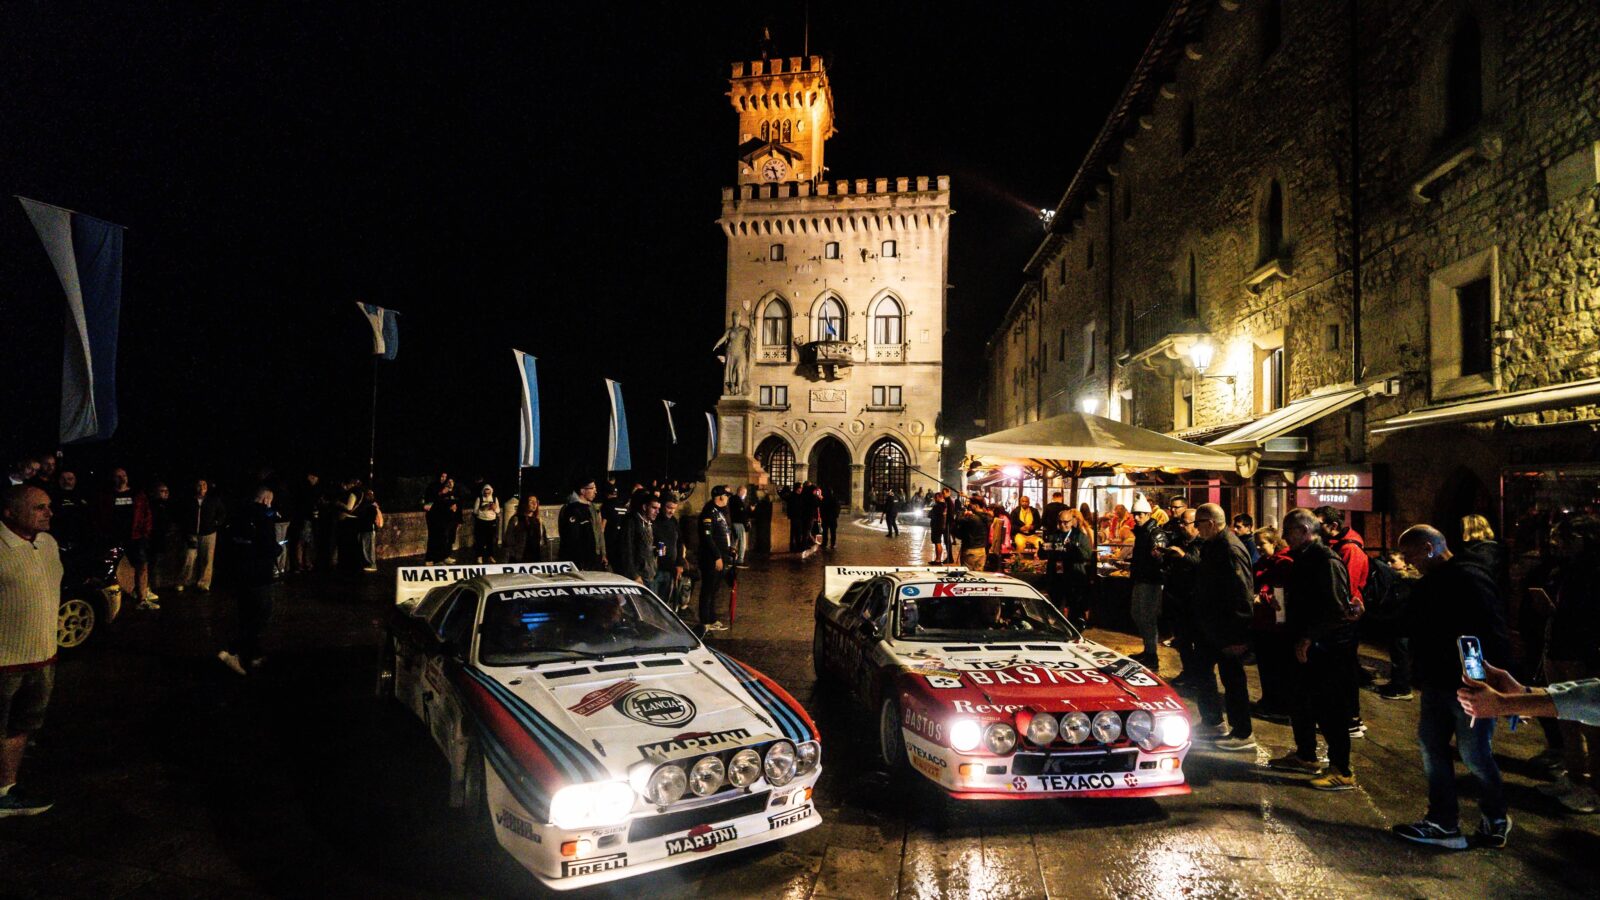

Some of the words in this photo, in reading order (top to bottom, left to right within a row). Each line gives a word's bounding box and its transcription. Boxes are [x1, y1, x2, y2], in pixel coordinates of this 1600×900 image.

[1308, 473, 1359, 493] OYSTER
[1319, 494, 1348, 503] BISTROT
[402, 567, 487, 582] MARTINI
[502, 564, 573, 575] RACING
[500, 588, 569, 601] LANCIA
[573, 587, 642, 595] MARTINI
[907, 587, 915, 595] 3
[967, 665, 1109, 685] BASTOS
[642, 700, 678, 712] LANCIA
[905, 708, 942, 741] BASTOS
[912, 744, 947, 768] TEXACO
[1038, 774, 1115, 791] TEXACO
[768, 806, 811, 829] PIRELLI
[669, 827, 736, 854] MARTINI
[561, 853, 628, 877] PIRELLI
